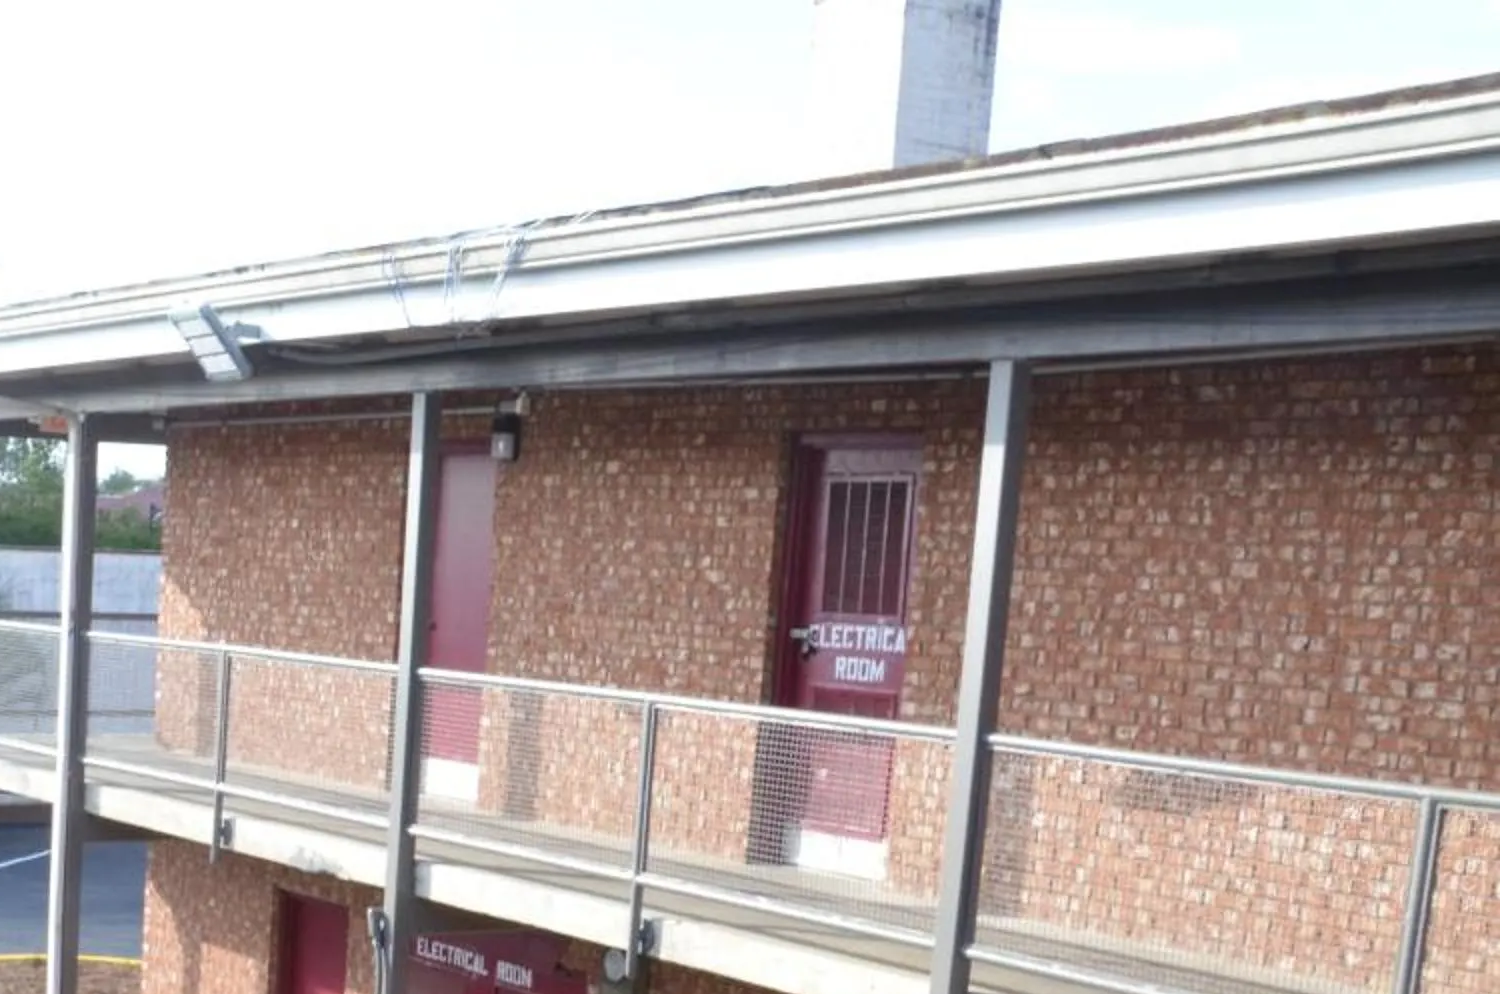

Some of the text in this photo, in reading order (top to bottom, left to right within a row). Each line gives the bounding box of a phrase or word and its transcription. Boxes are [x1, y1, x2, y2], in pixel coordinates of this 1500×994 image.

[808, 622, 906, 653] ELECTRICA
[835, 656, 885, 682] ROOM
[416, 937, 533, 988] ELECTRICAL ROOM
